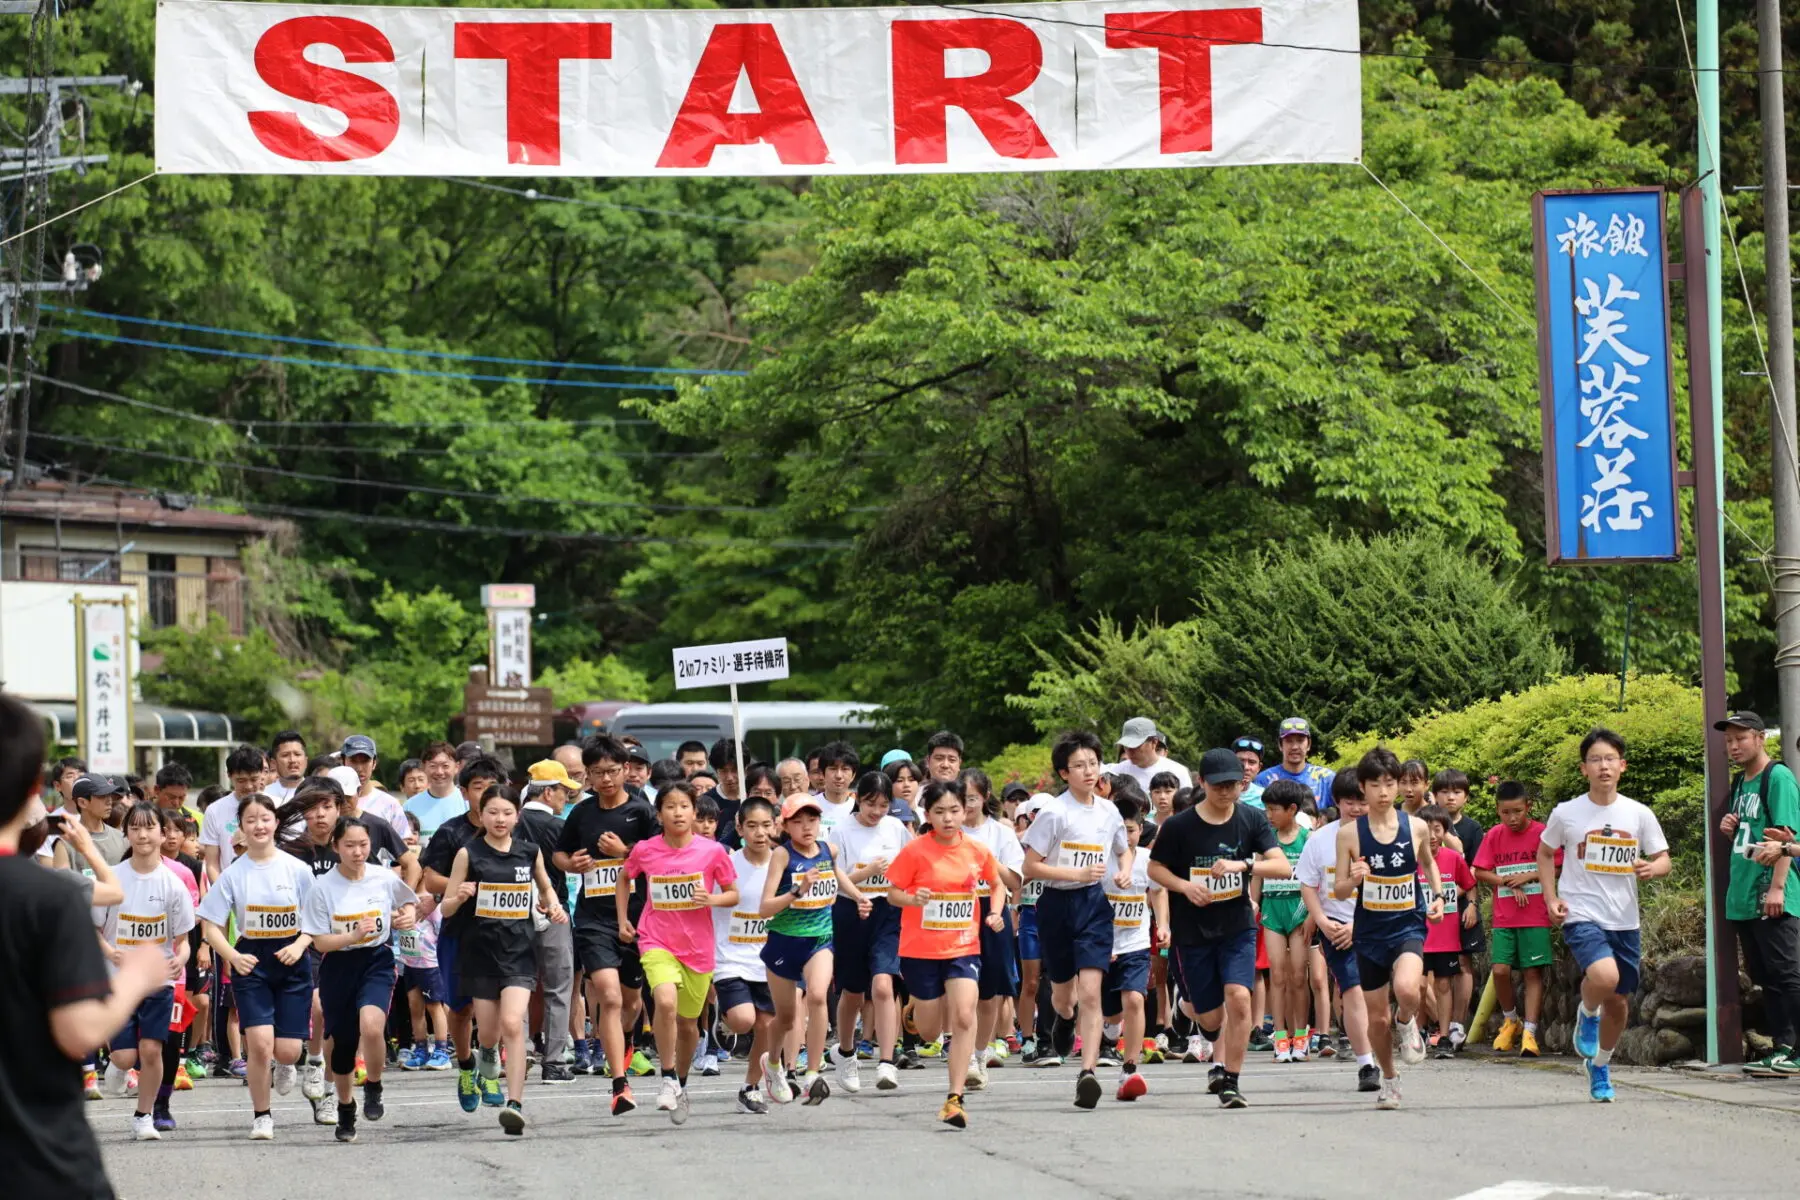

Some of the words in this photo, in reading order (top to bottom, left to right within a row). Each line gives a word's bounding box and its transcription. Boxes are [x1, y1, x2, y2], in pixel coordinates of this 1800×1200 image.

[247, 7, 1264, 167] START
[1556, 212, 1648, 258] 旅館
[1574, 273, 1654, 533] 芙蓉荘
[1369, 851, 1406, 869] 塩谷
[1600, 845, 1637, 863] 17008
[514, 866, 531, 874] THE
[515, 874, 530, 882] DAY
[1205, 871, 1241, 891] 17015
[492, 892, 529, 908] 16006
[1377, 882, 1414, 901] 17004
[938, 902, 973, 919] 16002
[1111, 902, 1145, 918] 17019
[129, 920, 165, 938] 16011
[259, 912, 297, 929] 16008
